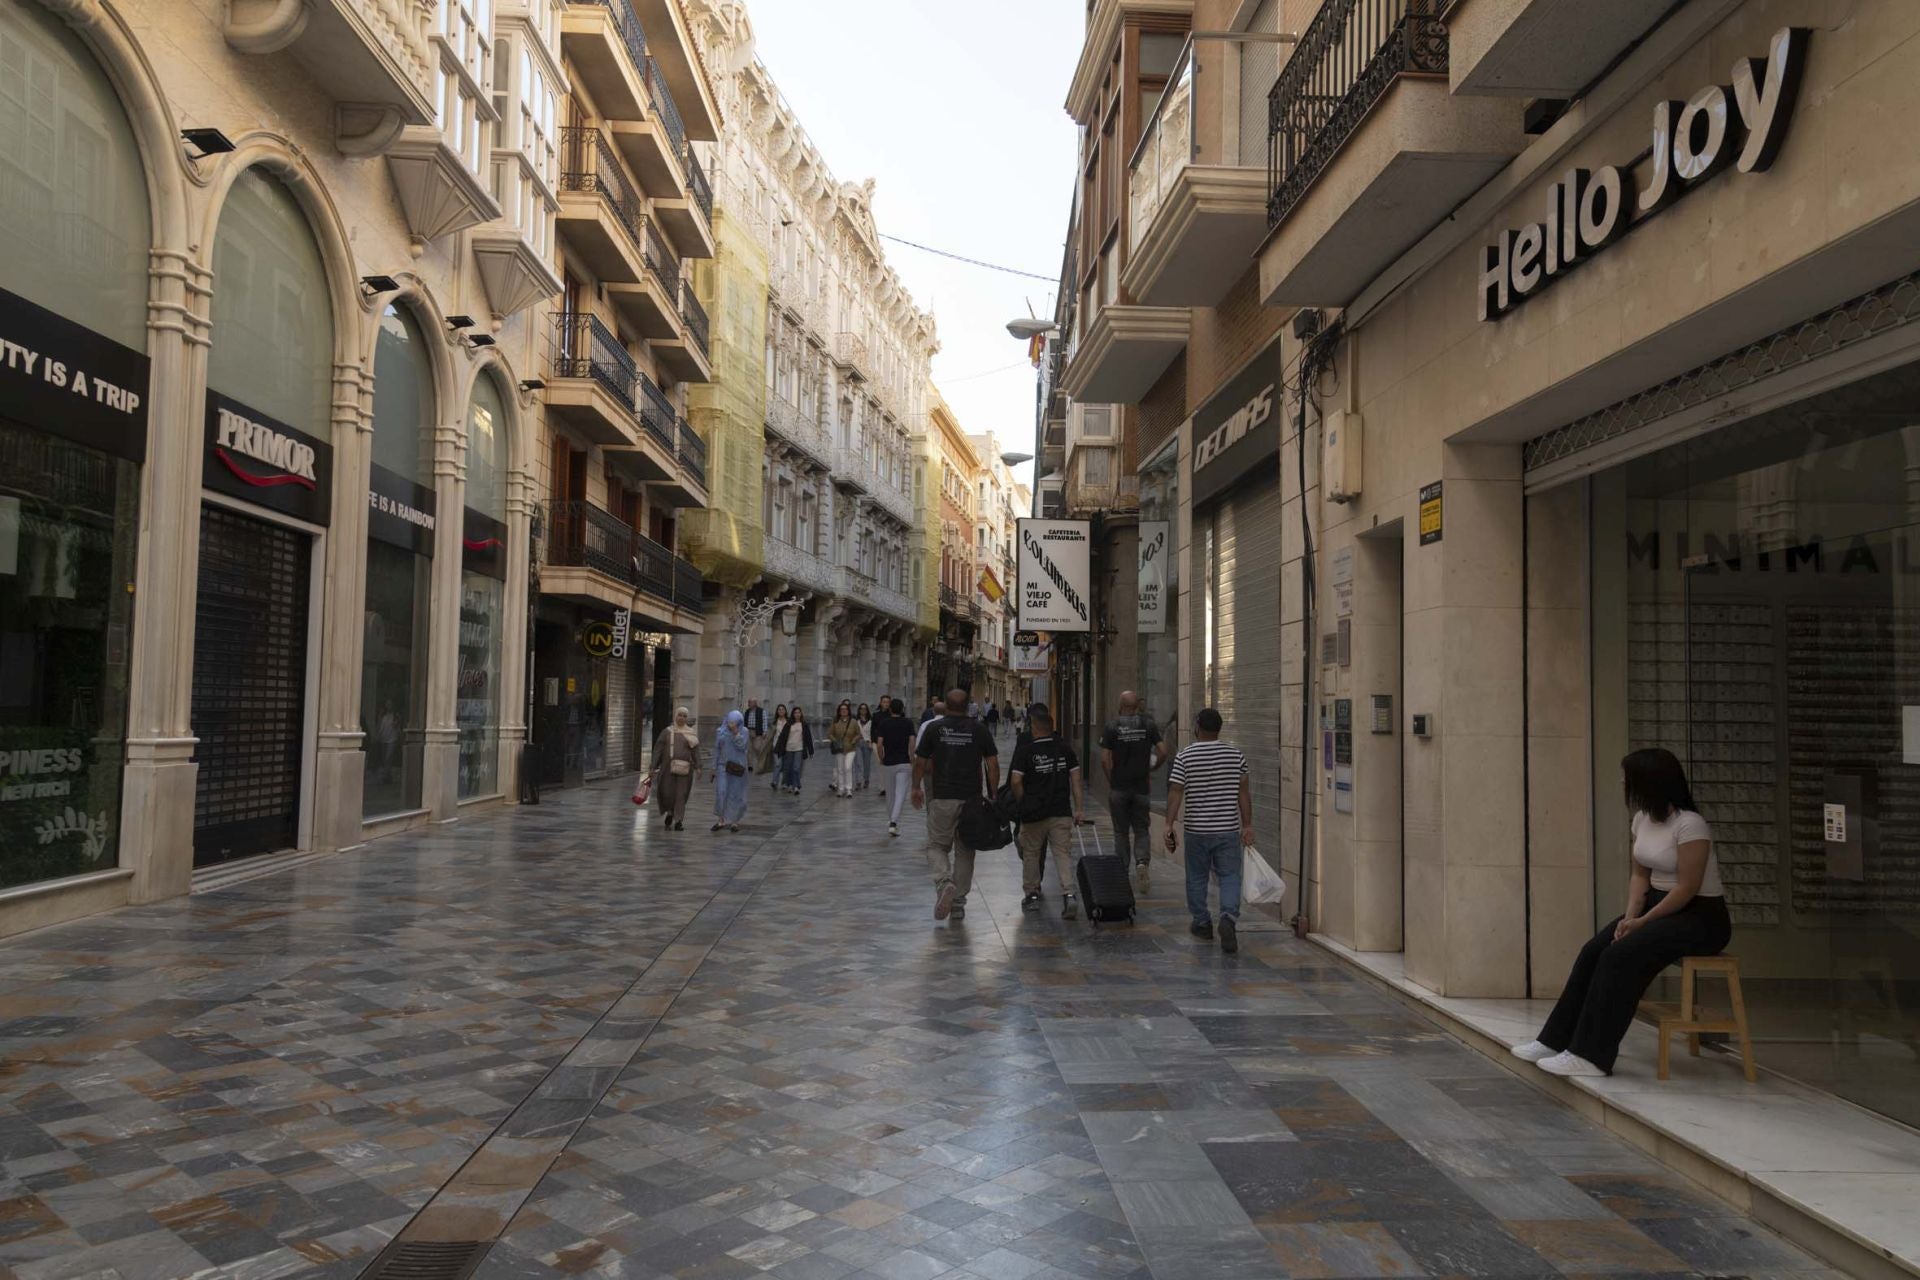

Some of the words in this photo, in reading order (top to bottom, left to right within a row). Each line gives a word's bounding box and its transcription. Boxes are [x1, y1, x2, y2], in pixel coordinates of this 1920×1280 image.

[1478, 165, 1622, 322] Hello
[44, 357, 67, 388] IS
[71, 370, 88, 397] A
[93, 377, 140, 414] TRIP
[217, 408, 316, 481] PRIMOR
[379, 494, 389, 512] IS
[389, 500, 397, 516] A
[398, 503, 435, 530] RAINBOW
[1026, 582, 1038, 590] MI
[1026, 591, 1052, 600] VIEJO
[1026, 598, 1048, 608] CAFÉ
[590, 633, 612, 647] IN
[611, 609, 628, 657] outlet
